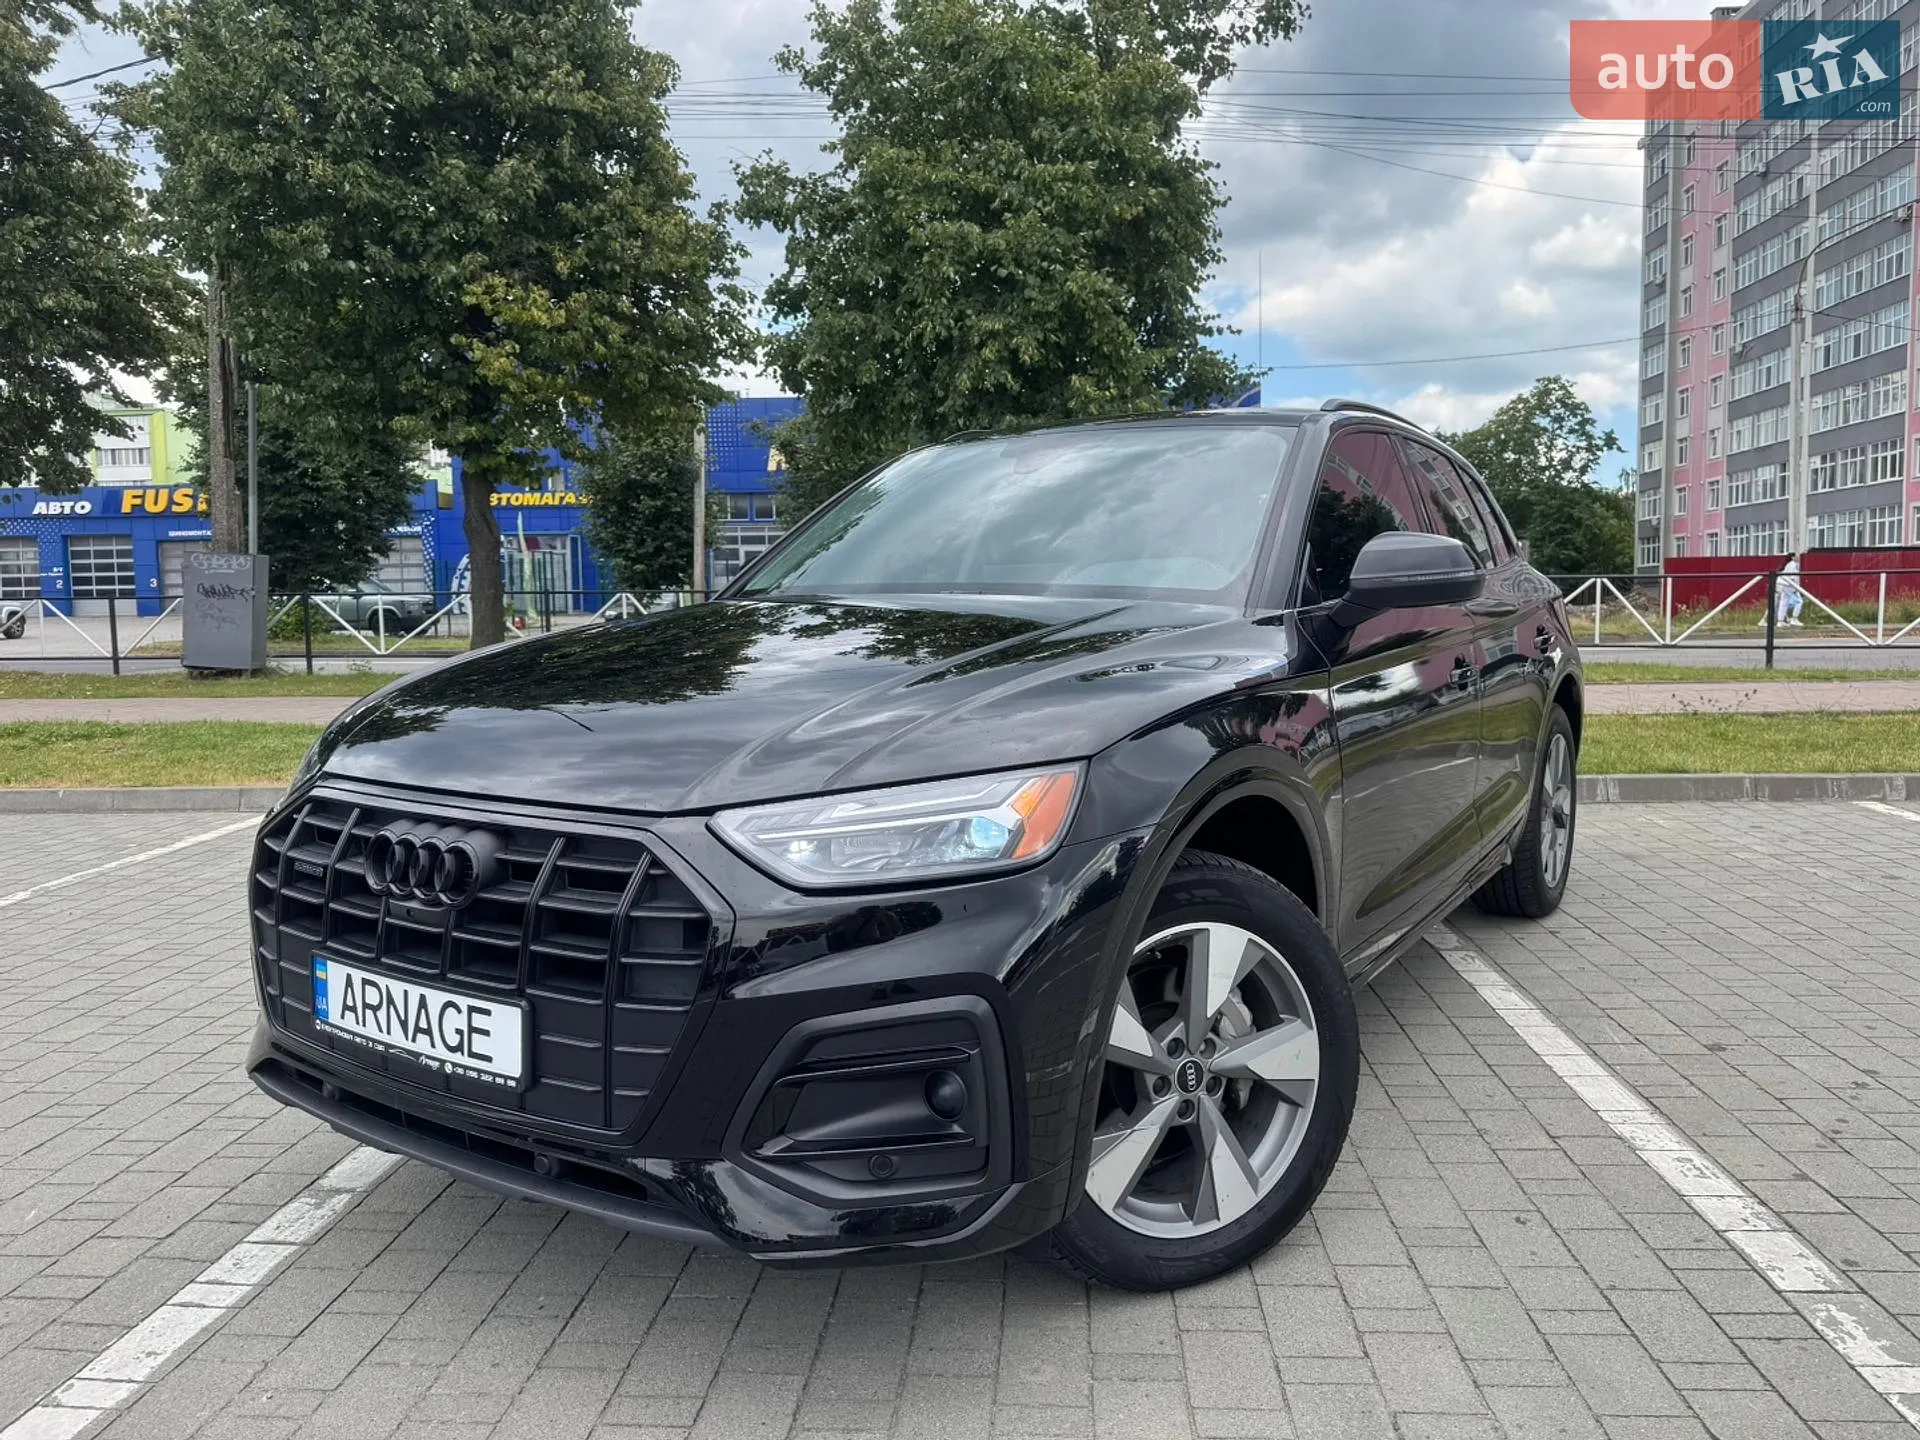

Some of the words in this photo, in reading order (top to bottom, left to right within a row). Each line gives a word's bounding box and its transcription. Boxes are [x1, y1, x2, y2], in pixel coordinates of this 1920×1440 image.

[32, 501, 93, 515] АВТО
[55, 579, 64, 589] 2
[149, 578, 158, 588] 3
[340, 972, 494, 1064] ARNAGE
